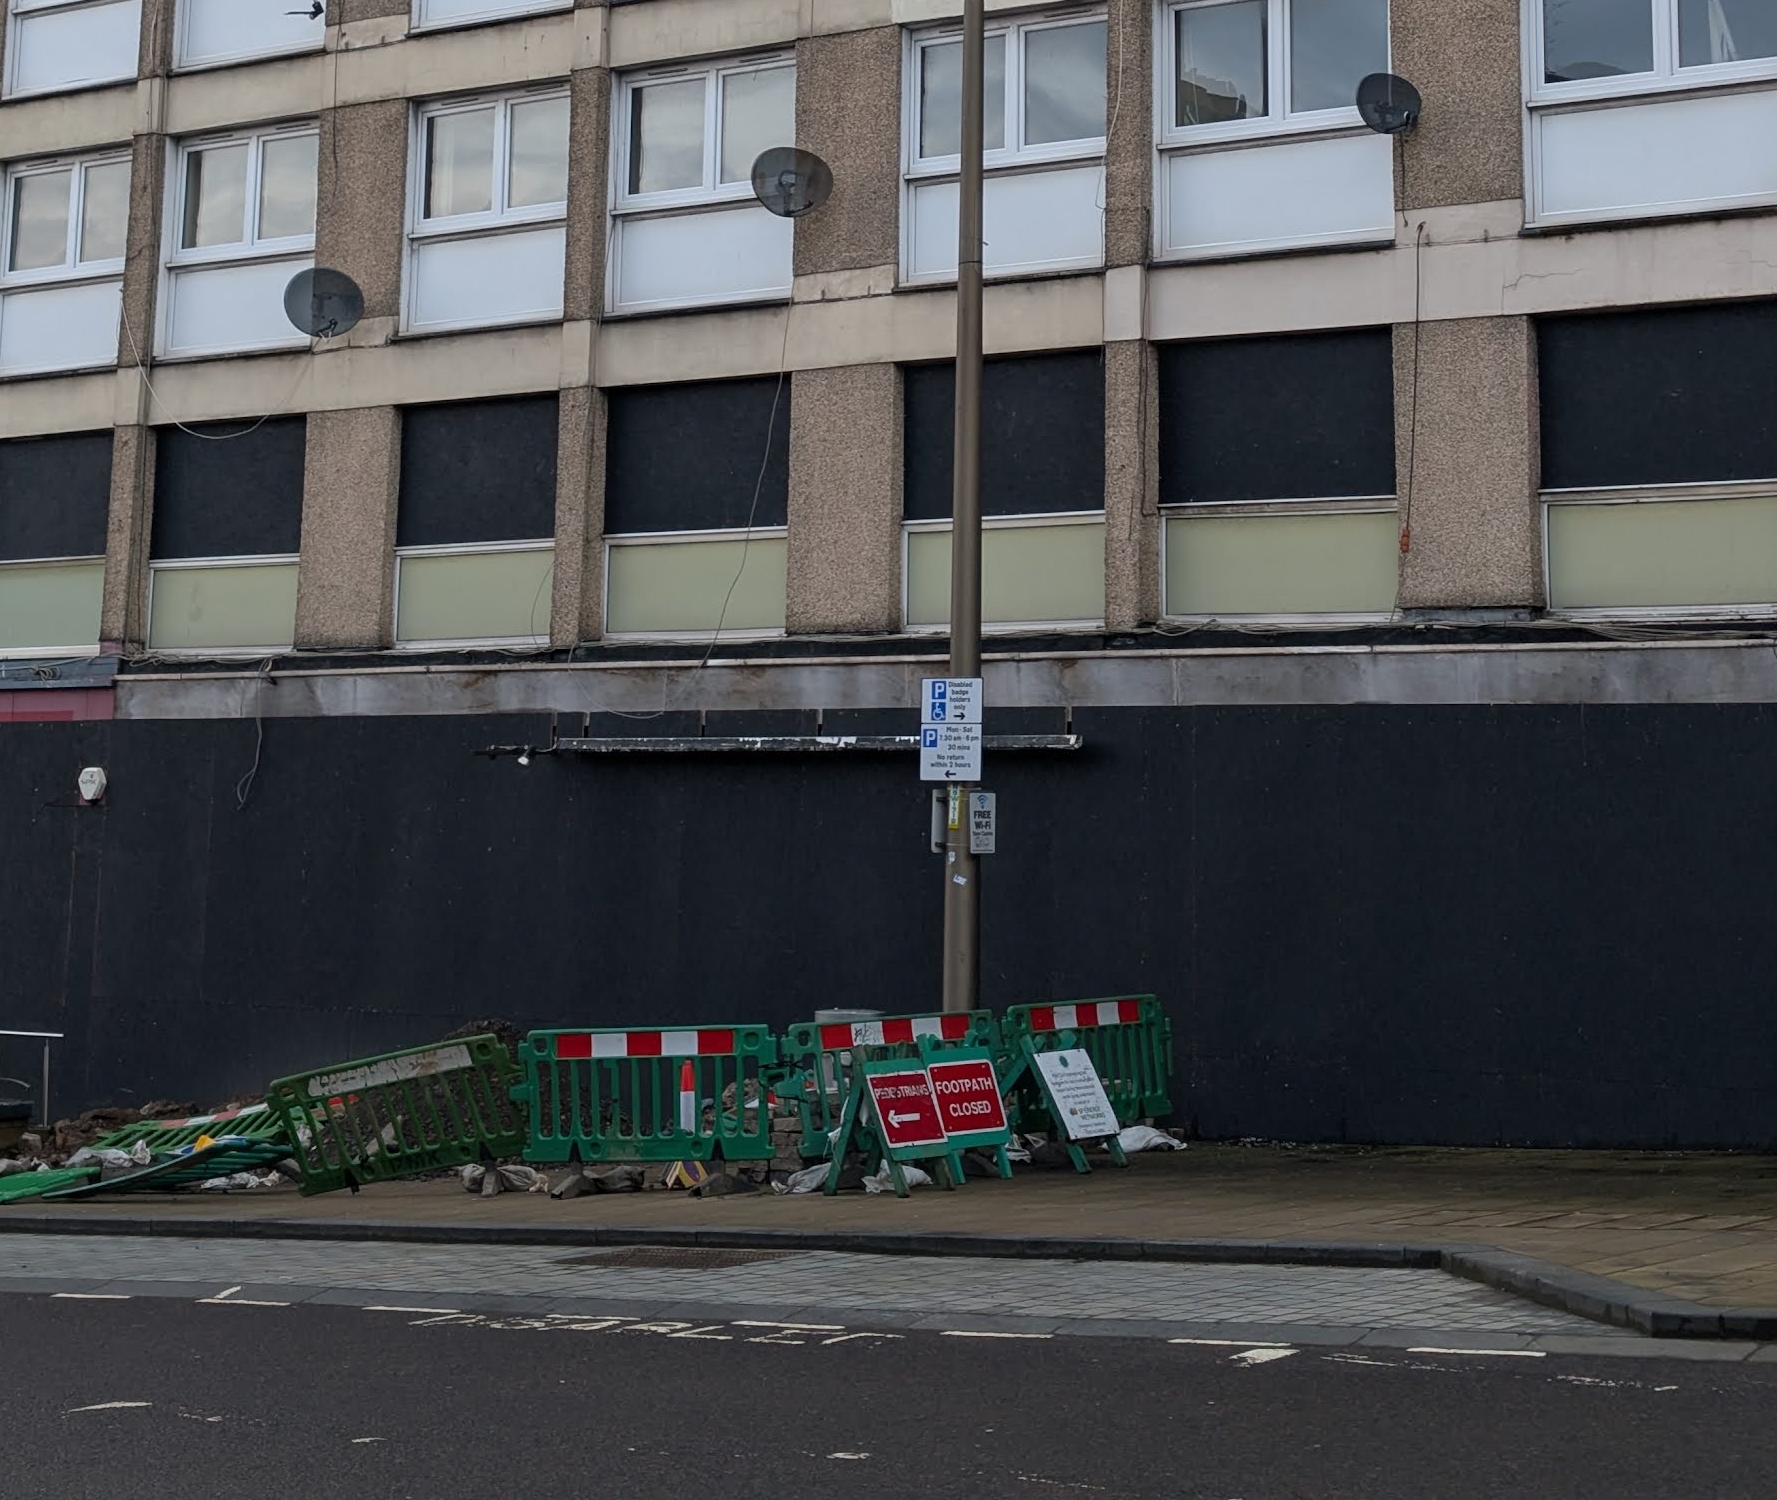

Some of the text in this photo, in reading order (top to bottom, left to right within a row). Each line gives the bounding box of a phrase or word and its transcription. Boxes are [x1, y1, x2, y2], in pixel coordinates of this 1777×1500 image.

[973, 810, 992, 819] FREE
[974, 821, 991, 830] Wi-Fi
[935, 1077, 994, 1094] FOOTPATH
[949, 1100, 992, 1117] CLOSED
